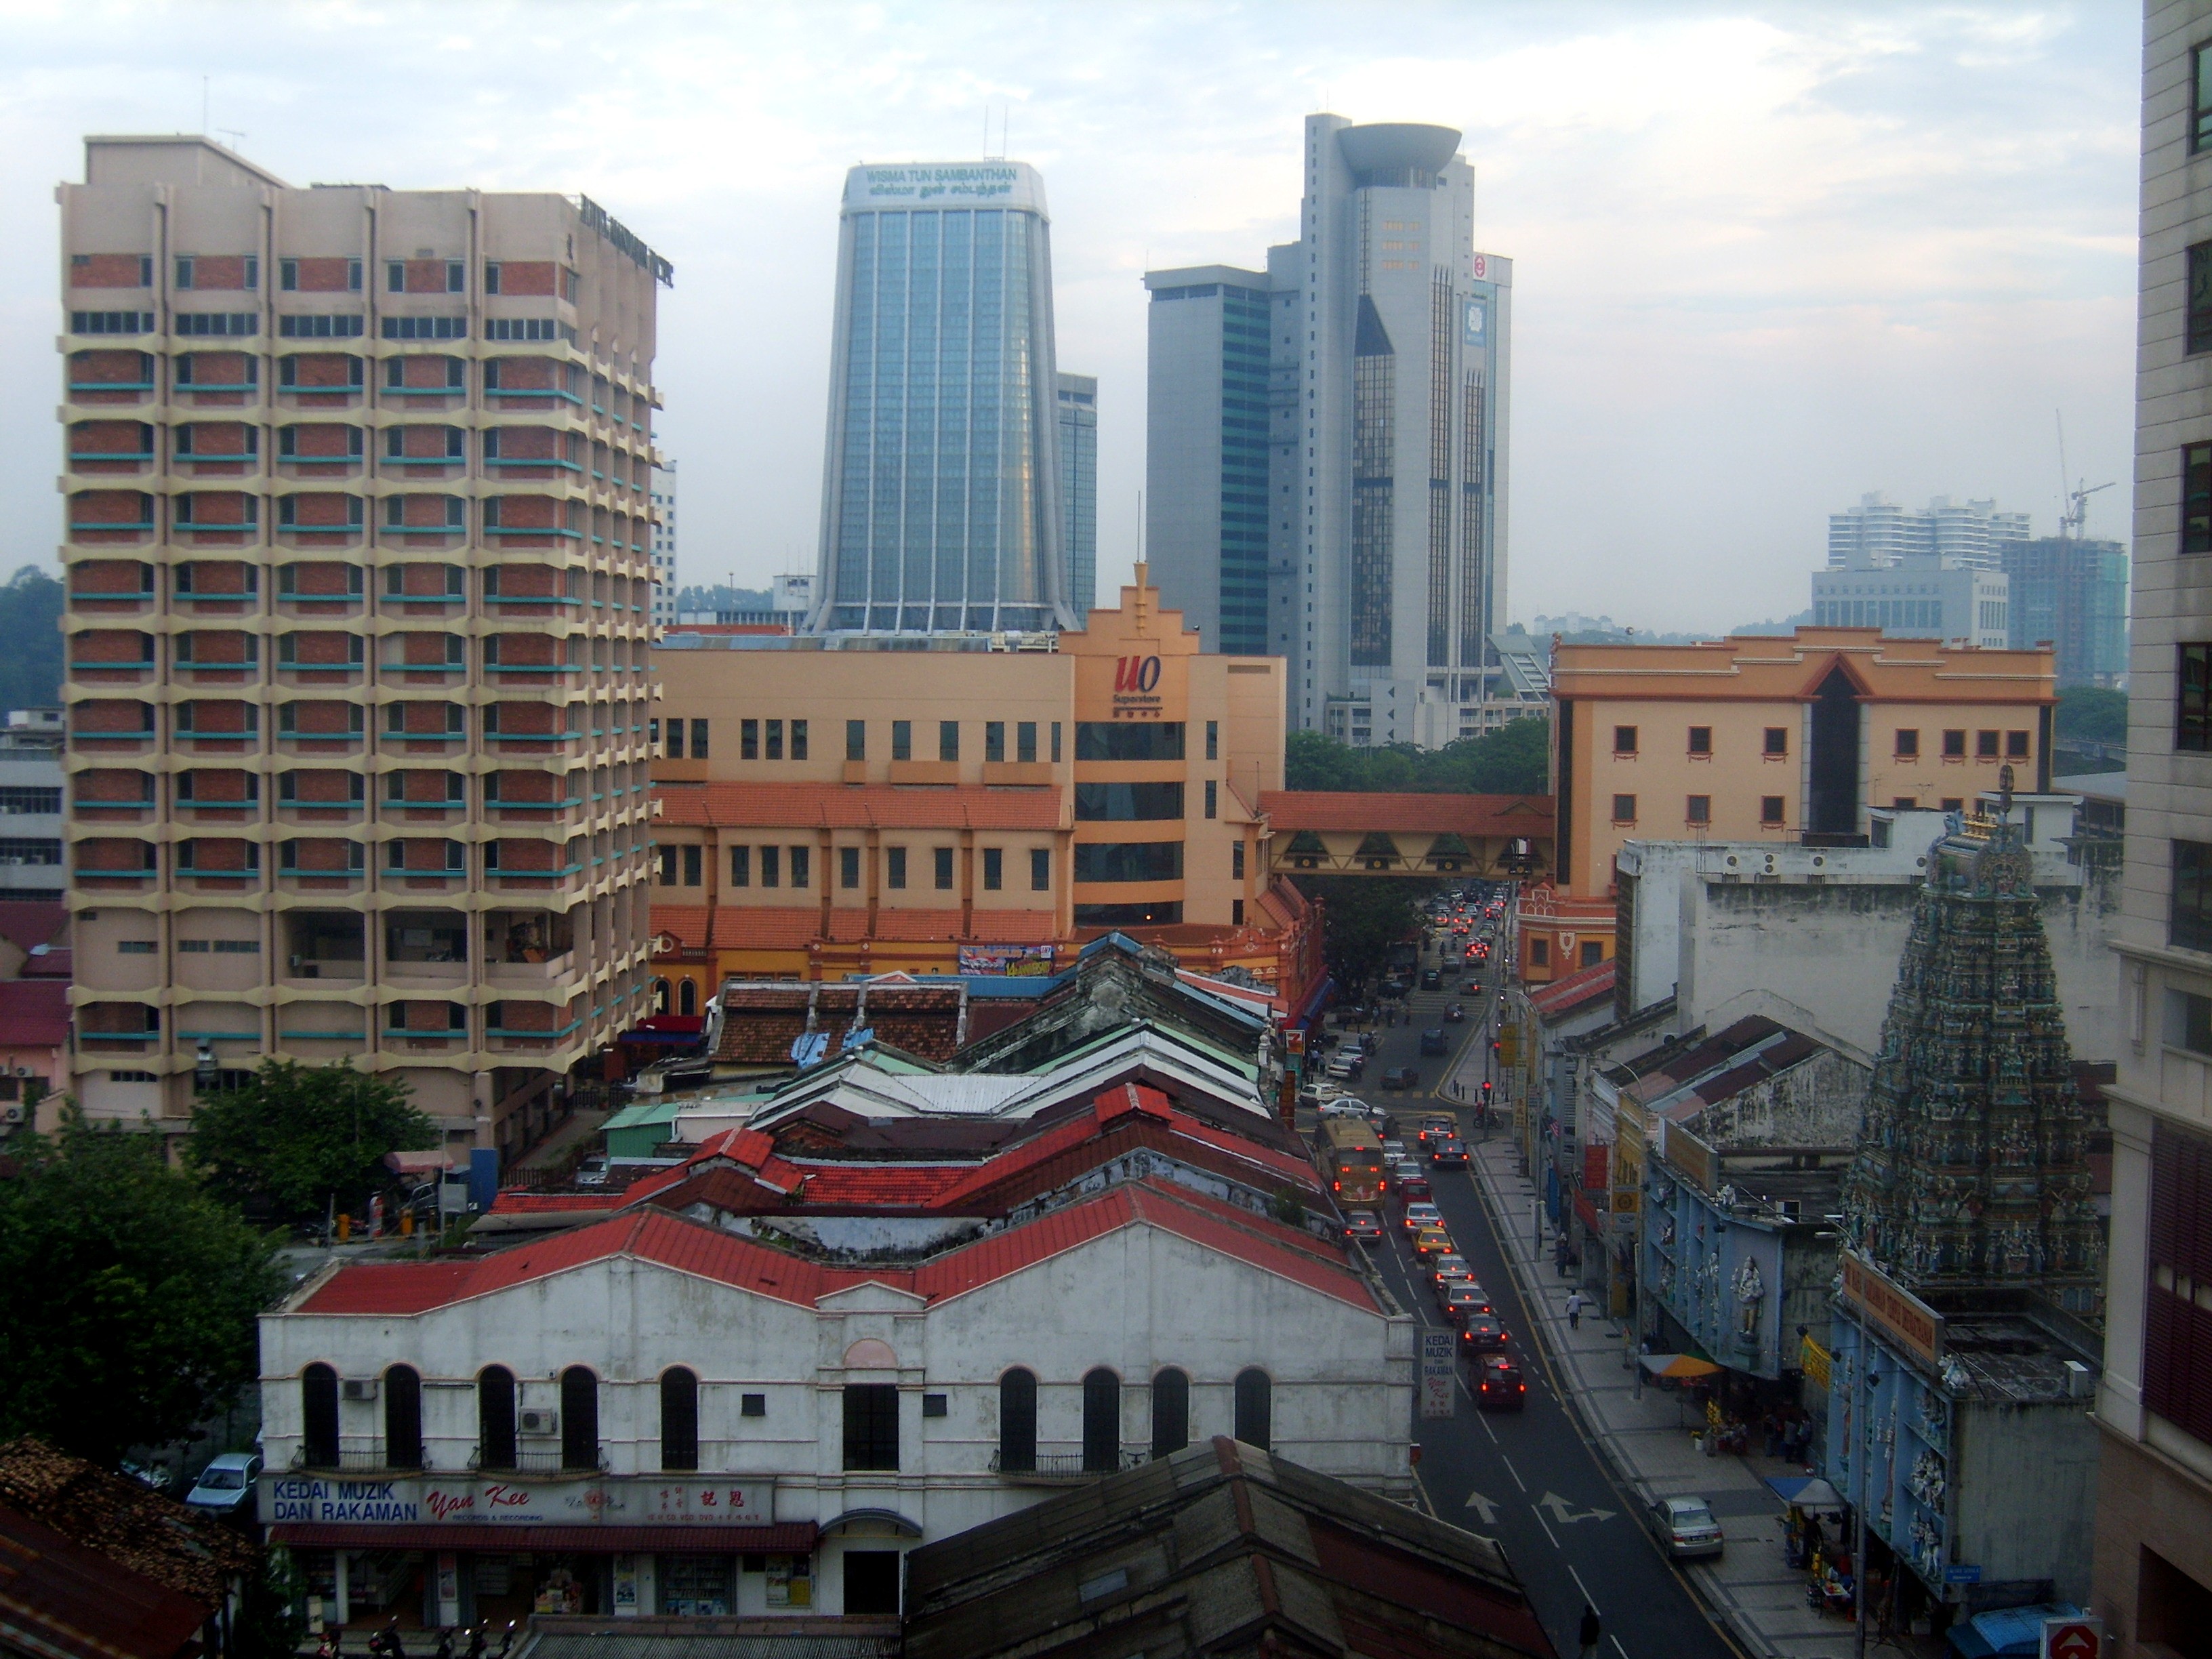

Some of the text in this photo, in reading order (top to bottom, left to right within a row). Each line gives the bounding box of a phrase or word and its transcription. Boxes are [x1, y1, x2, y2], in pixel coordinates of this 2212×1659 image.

[866, 168, 1017, 183] WISMA TUN SAMBANTHAN
[1113, 694, 1161, 704] Superstore
[1426, 1336, 1453, 1346] KEDAI
[1425, 1347, 1453, 1357] MUZIK
[1425, 1366, 1453, 1375] RAKAMAN
[1427, 1377, 1446, 1389] Yan
[1433, 1389, 1450, 1399] Kee
[274, 1482, 394, 1500] KEDAI MUZIK
[426, 1484, 529, 1520] Yan Kee
[274, 1502, 417, 1521] DAN RAKAMAN
